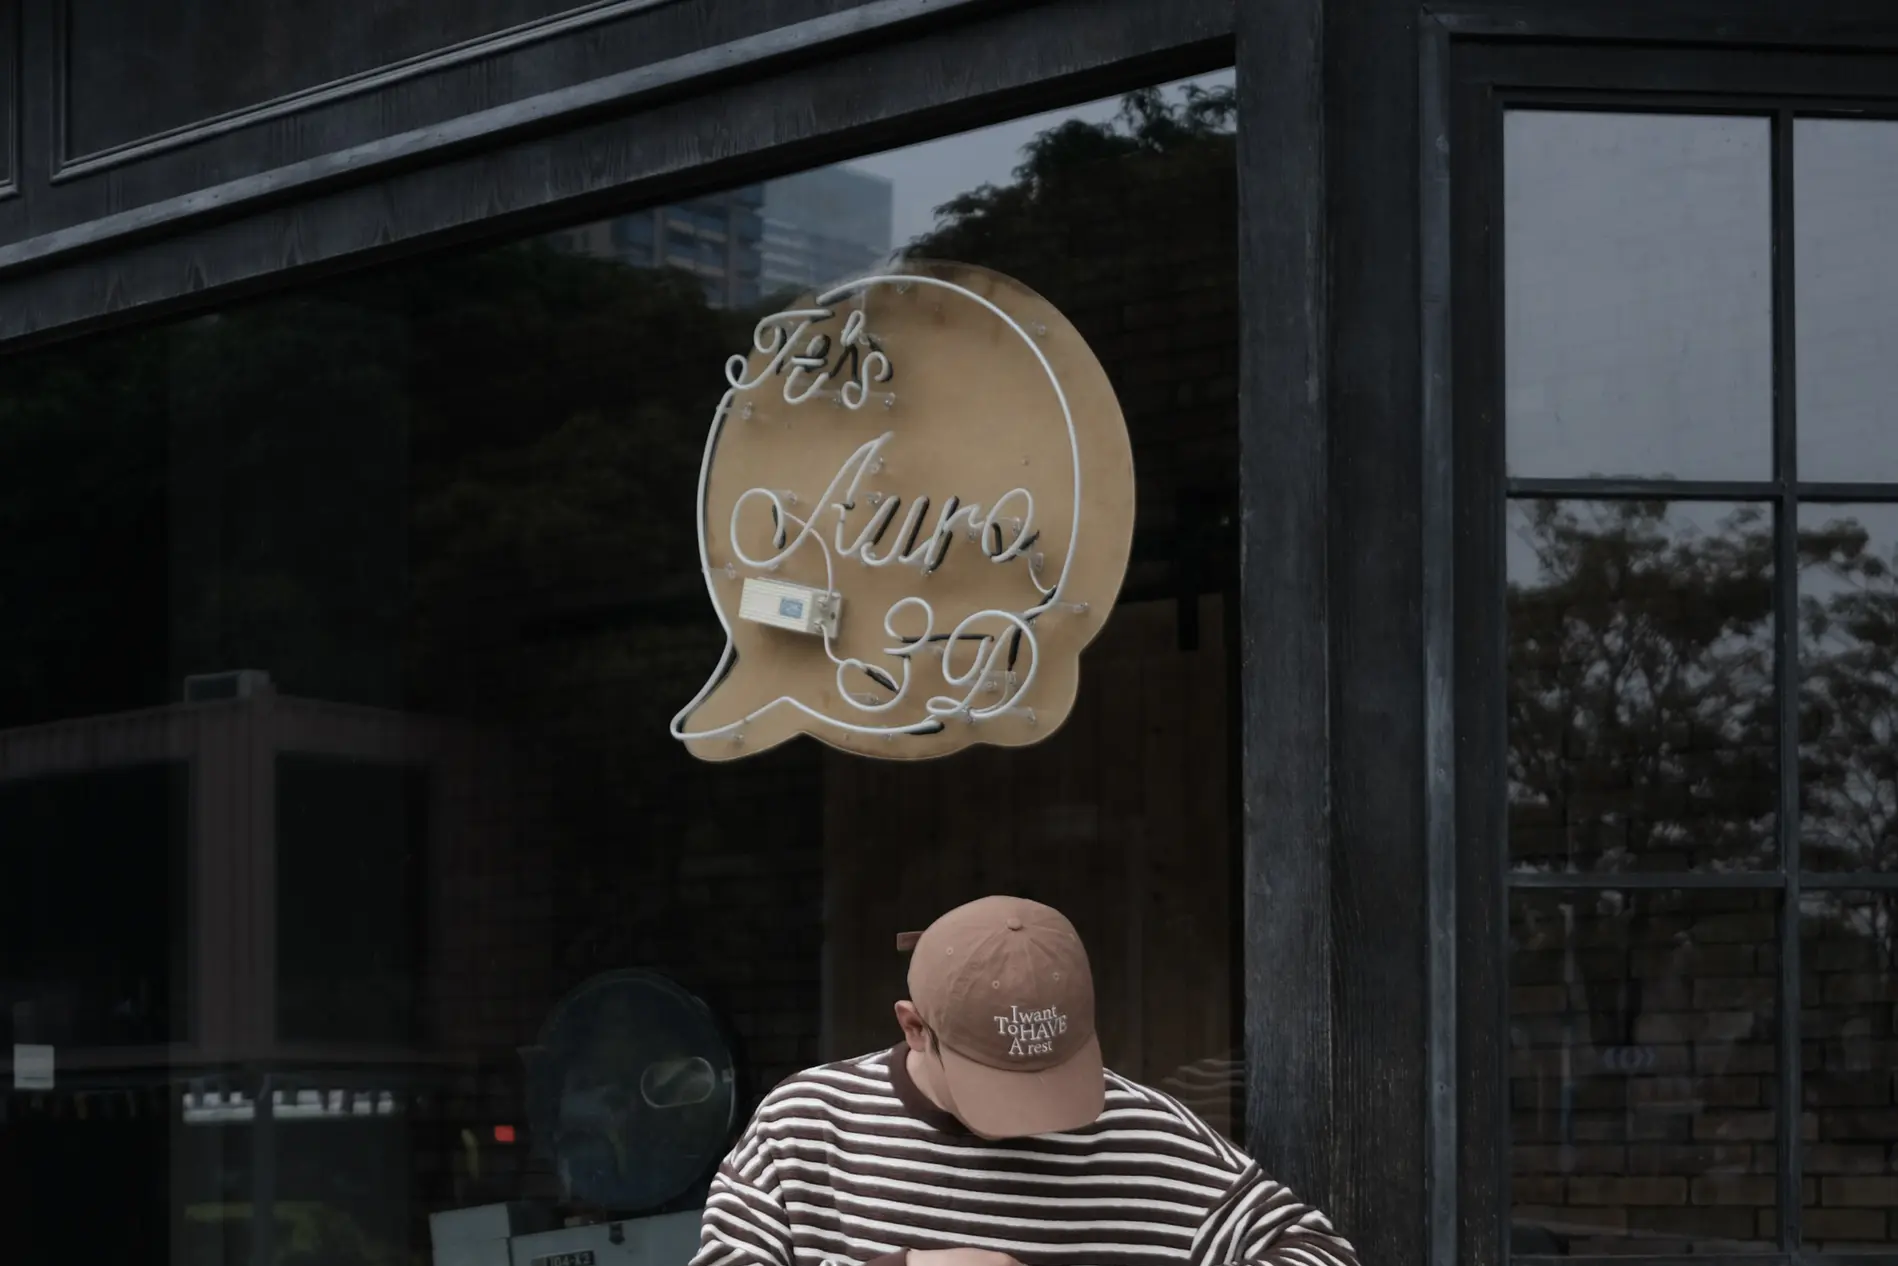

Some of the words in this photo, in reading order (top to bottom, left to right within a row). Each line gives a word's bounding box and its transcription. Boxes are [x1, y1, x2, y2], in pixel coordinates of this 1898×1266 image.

[730, 432, 1040, 573] Auro
[1010, 1005, 1018, 1024] I
[1018, 1004, 1058, 1024] want
[993, 1015, 1019, 1035] To
[1019, 1014, 1067, 1041] HAVE
[1008, 1036, 1025, 1055] A
[1027, 1041, 1053, 1055] rest
